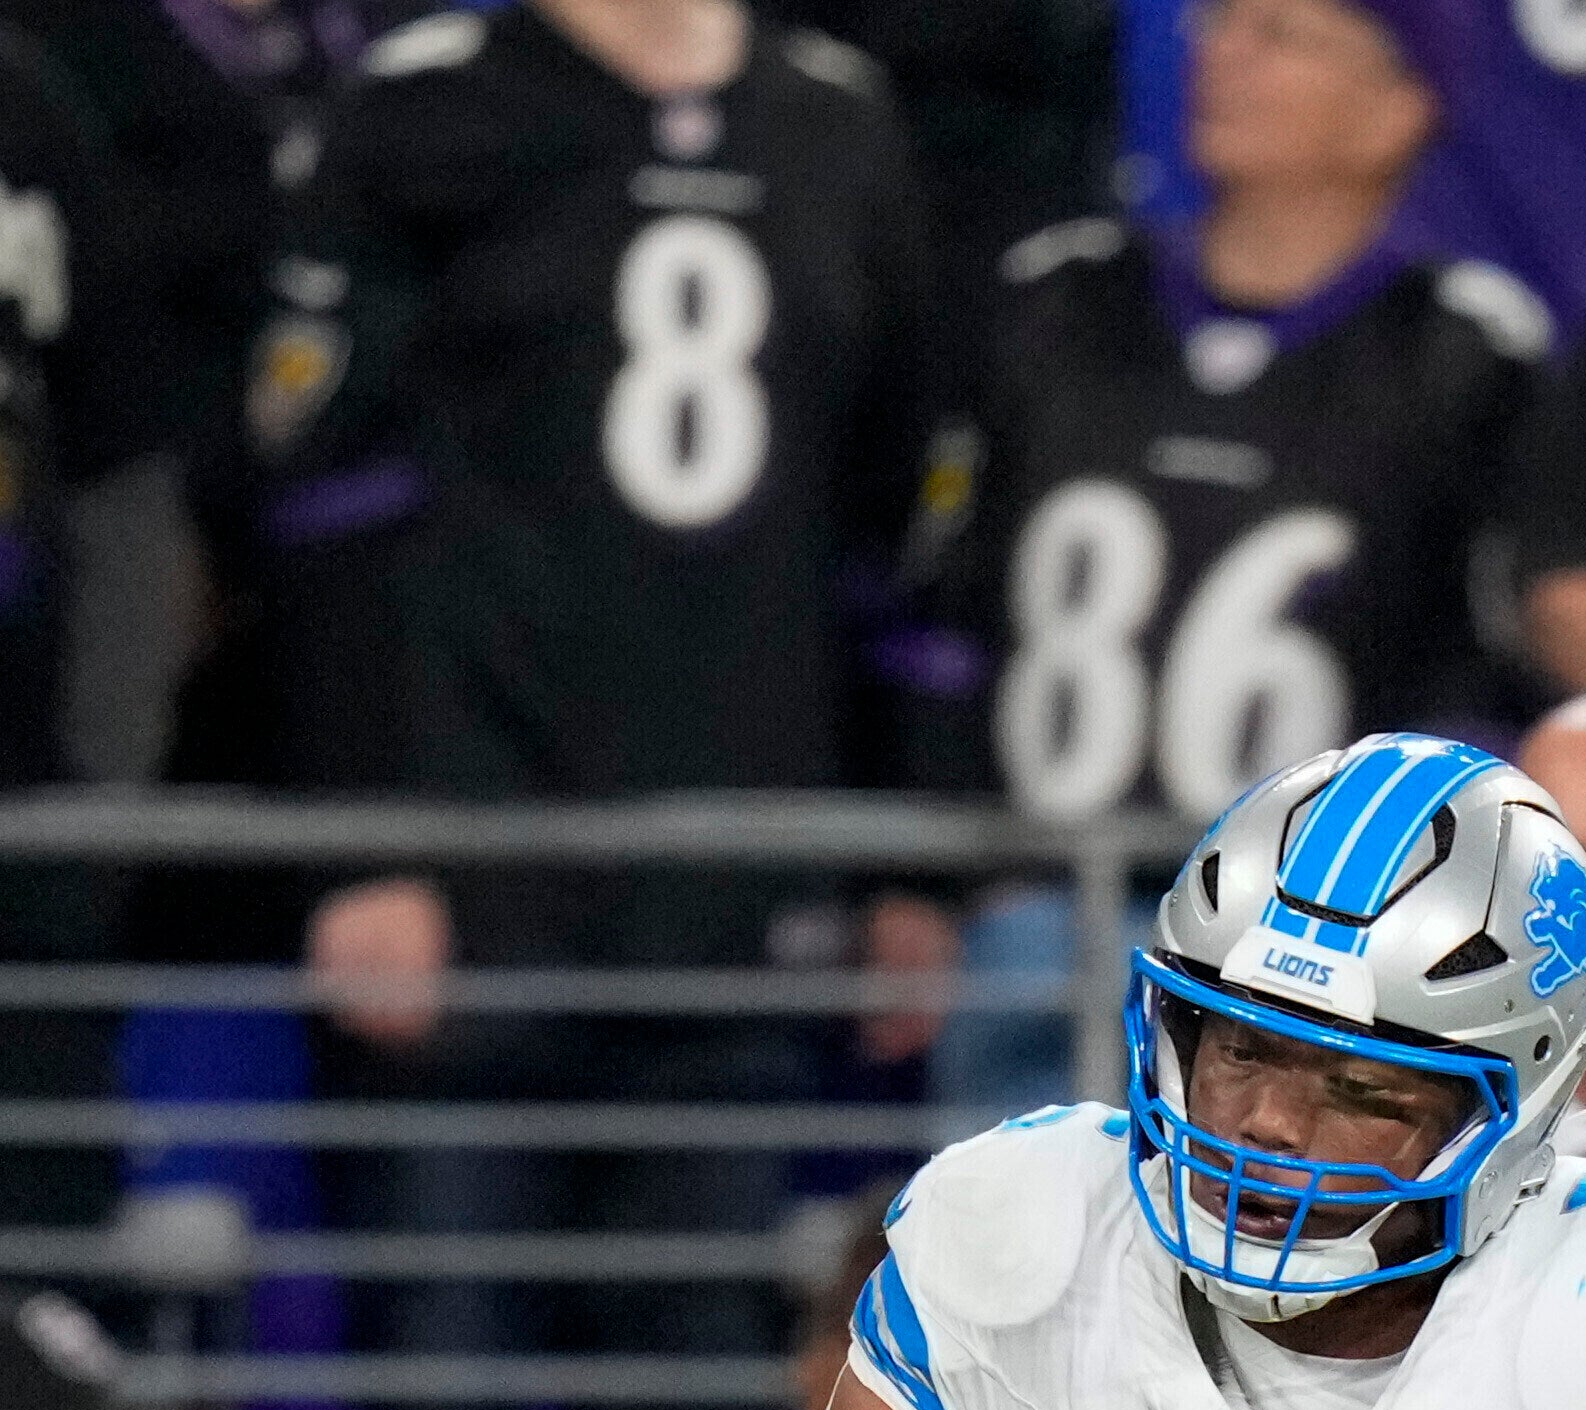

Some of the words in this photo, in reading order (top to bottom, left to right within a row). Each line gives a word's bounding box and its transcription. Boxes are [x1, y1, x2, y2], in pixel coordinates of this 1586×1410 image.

[603, 214, 771, 528] 8
[995, 477, 1355, 822] 86
[1263, 947, 1334, 986] LIONS
